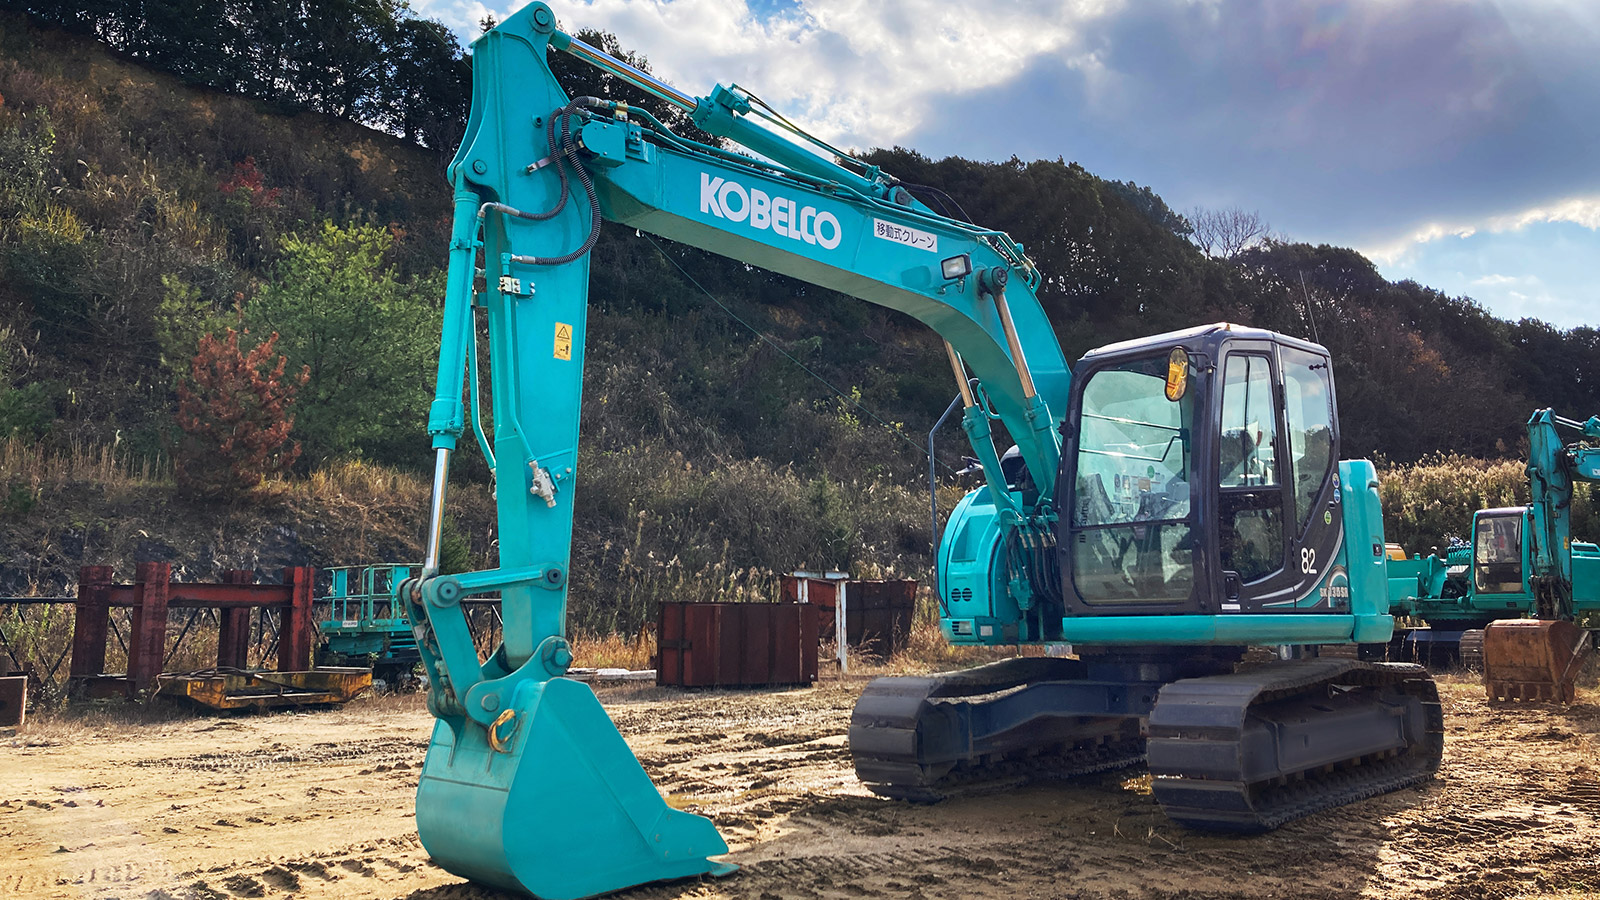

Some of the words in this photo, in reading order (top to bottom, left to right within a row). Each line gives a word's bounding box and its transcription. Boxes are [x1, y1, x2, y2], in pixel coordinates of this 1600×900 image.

[700, 172, 842, 250] KOBELCO
[876, 221, 935, 249] 移動式クレーン
[1301, 547, 1317, 574] 82
